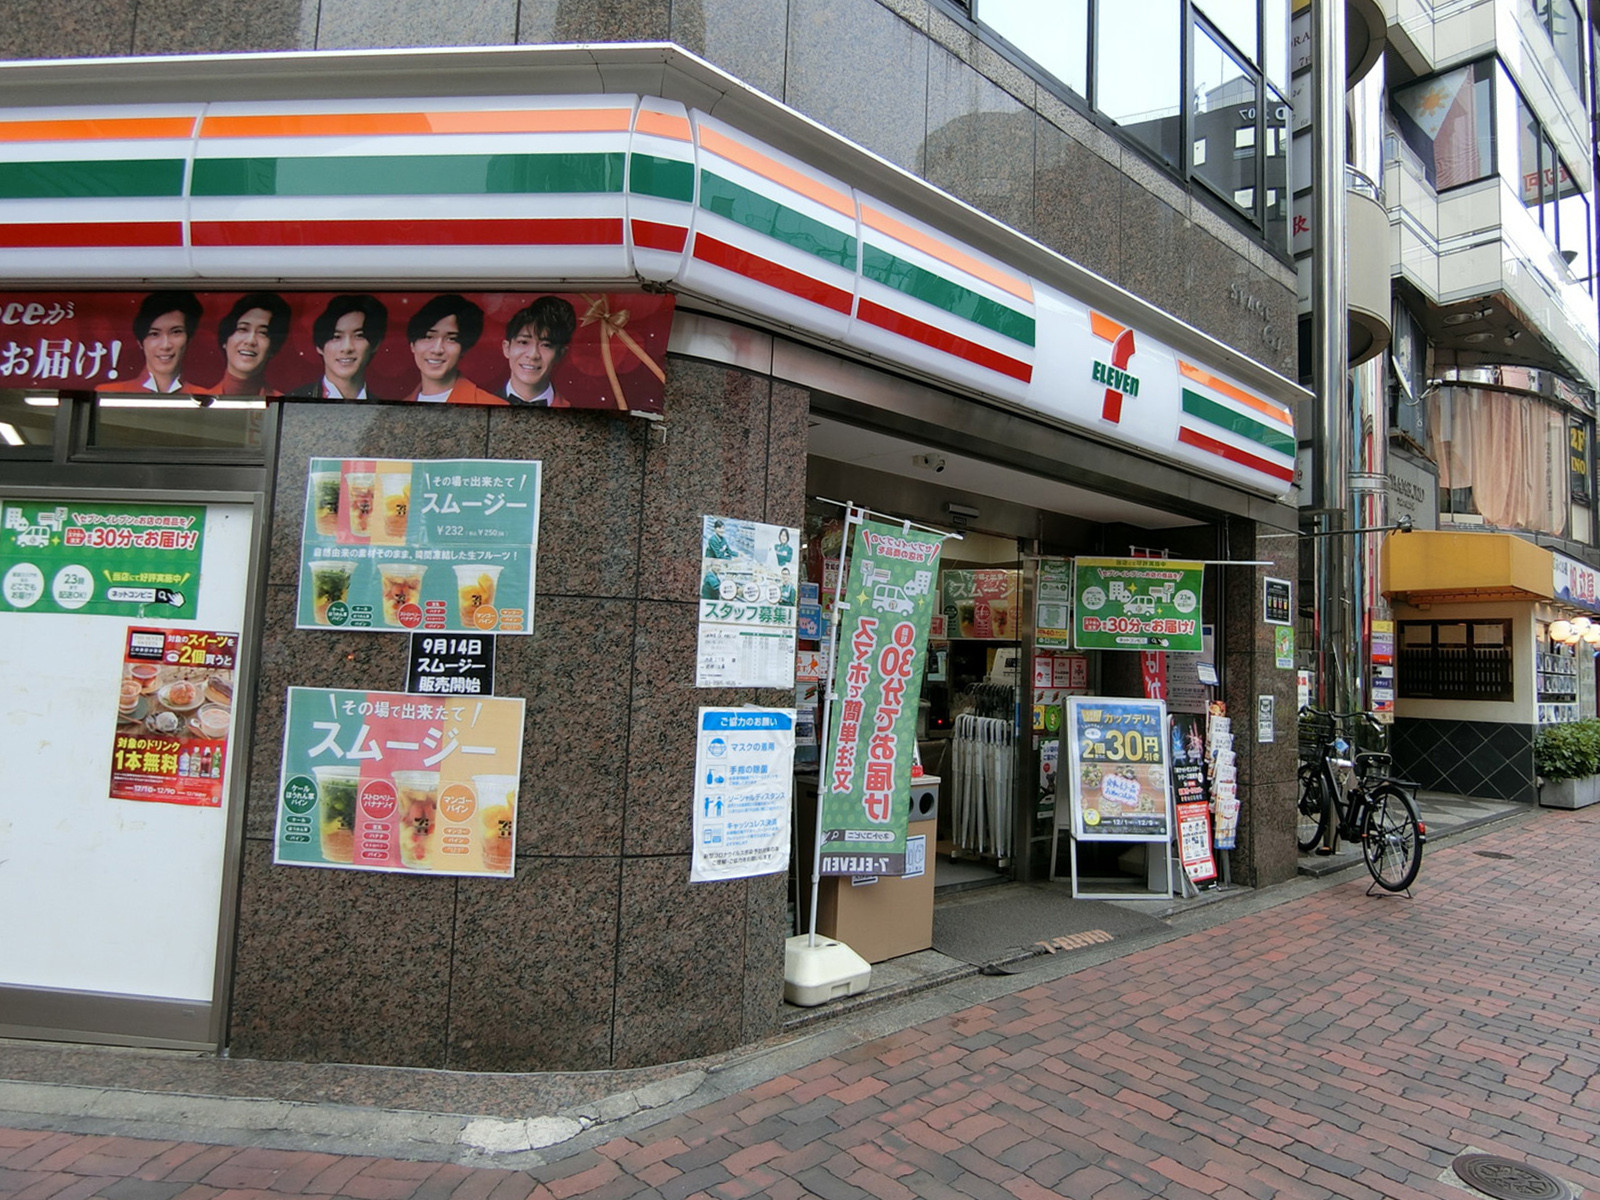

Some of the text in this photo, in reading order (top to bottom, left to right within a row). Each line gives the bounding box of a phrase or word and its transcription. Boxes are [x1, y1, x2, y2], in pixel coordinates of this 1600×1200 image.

[0, 301, 75, 325] ceが
[433, 476, 515, 488] その場で出来たて
[421, 492, 527, 516] スムージー
[111, 591, 153, 599] ネットコンビニ
[705, 602, 793, 625] スタッフ募集!
[422, 639, 482, 656] 9月14日
[417, 658, 486, 673] スムージー
[418, 676, 482, 693] 販売開始
[342, 700, 466, 721] その場で出来たて
[720, 716, 778, 727] ご協力のお願い
[117, 737, 181, 752] 対象のドリンク
[308, 721, 496, 767] スムージー
[115, 749, 178, 774] 1本無料
[363, 793, 395, 801] ストロベリー
[443, 796, 473, 804] マンゴー
